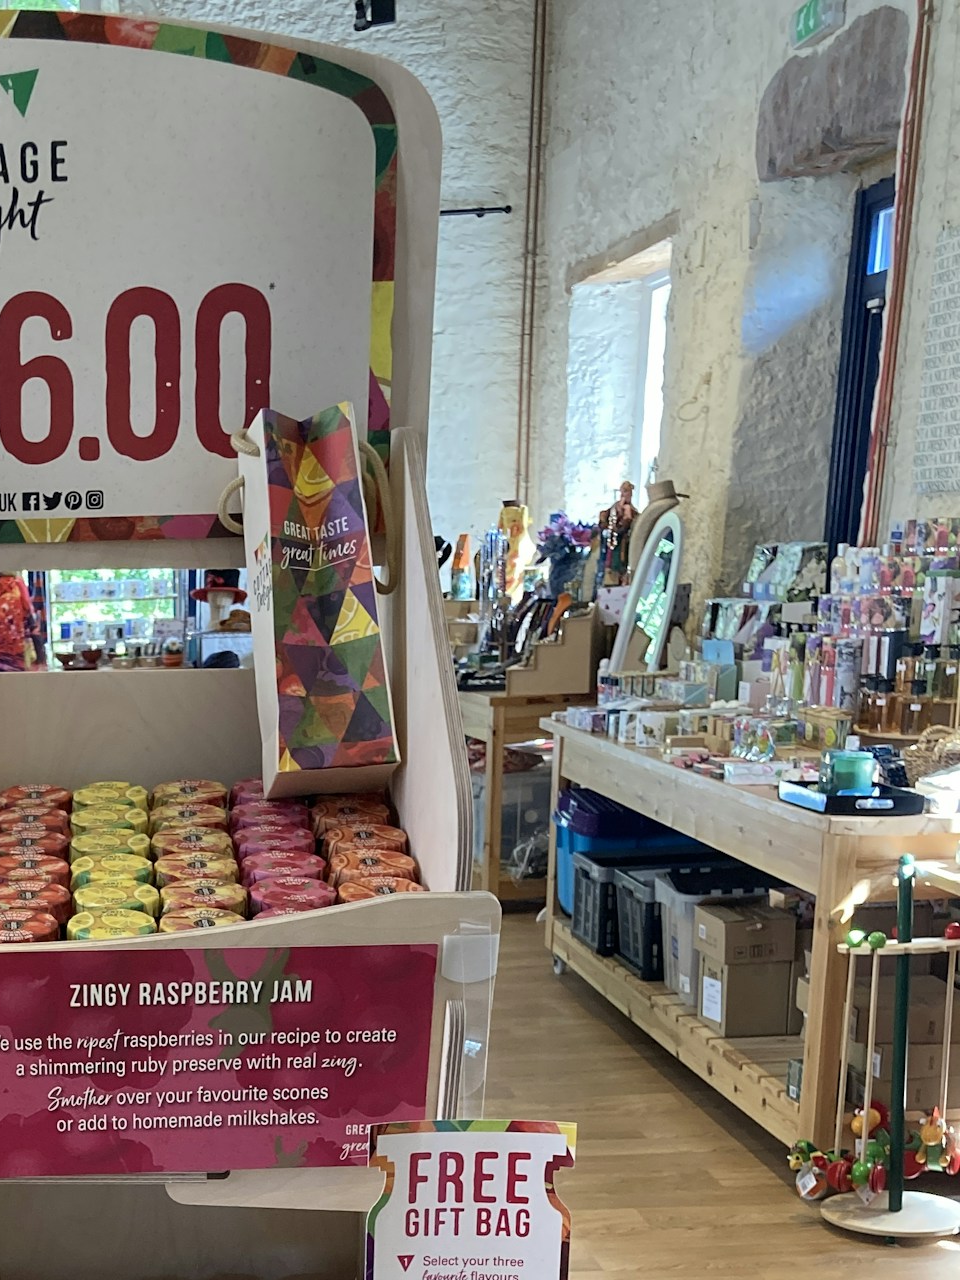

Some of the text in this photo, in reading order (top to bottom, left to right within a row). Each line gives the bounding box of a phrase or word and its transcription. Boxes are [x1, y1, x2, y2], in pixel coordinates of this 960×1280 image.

[284, 517, 349, 541] GREAT TASTE
[281, 540, 356, 569] great times
[69, 980, 312, 1007] ZINGY RASPBERRY JAM
[15, 1038, 42, 1051] use
[47, 1035, 72, 1050] the
[77, 1029, 122, 1057] ripest
[124, 1030, 213, 1051] raspberries
[219, 1031, 233, 1046] in
[238, 1033, 265, 1045] our
[270, 1030, 320, 1047] recipe
[325, 1030, 341, 1044] to
[346, 1029, 396, 1043] create
[16, 1054, 362, 1079] a shimmering ruby preserve with real zing.
[408, 1152, 531, 1204] FREE
[405, 1208, 530, 1237] GIFT BAG
[423, 1256, 524, 1268] Select your three
